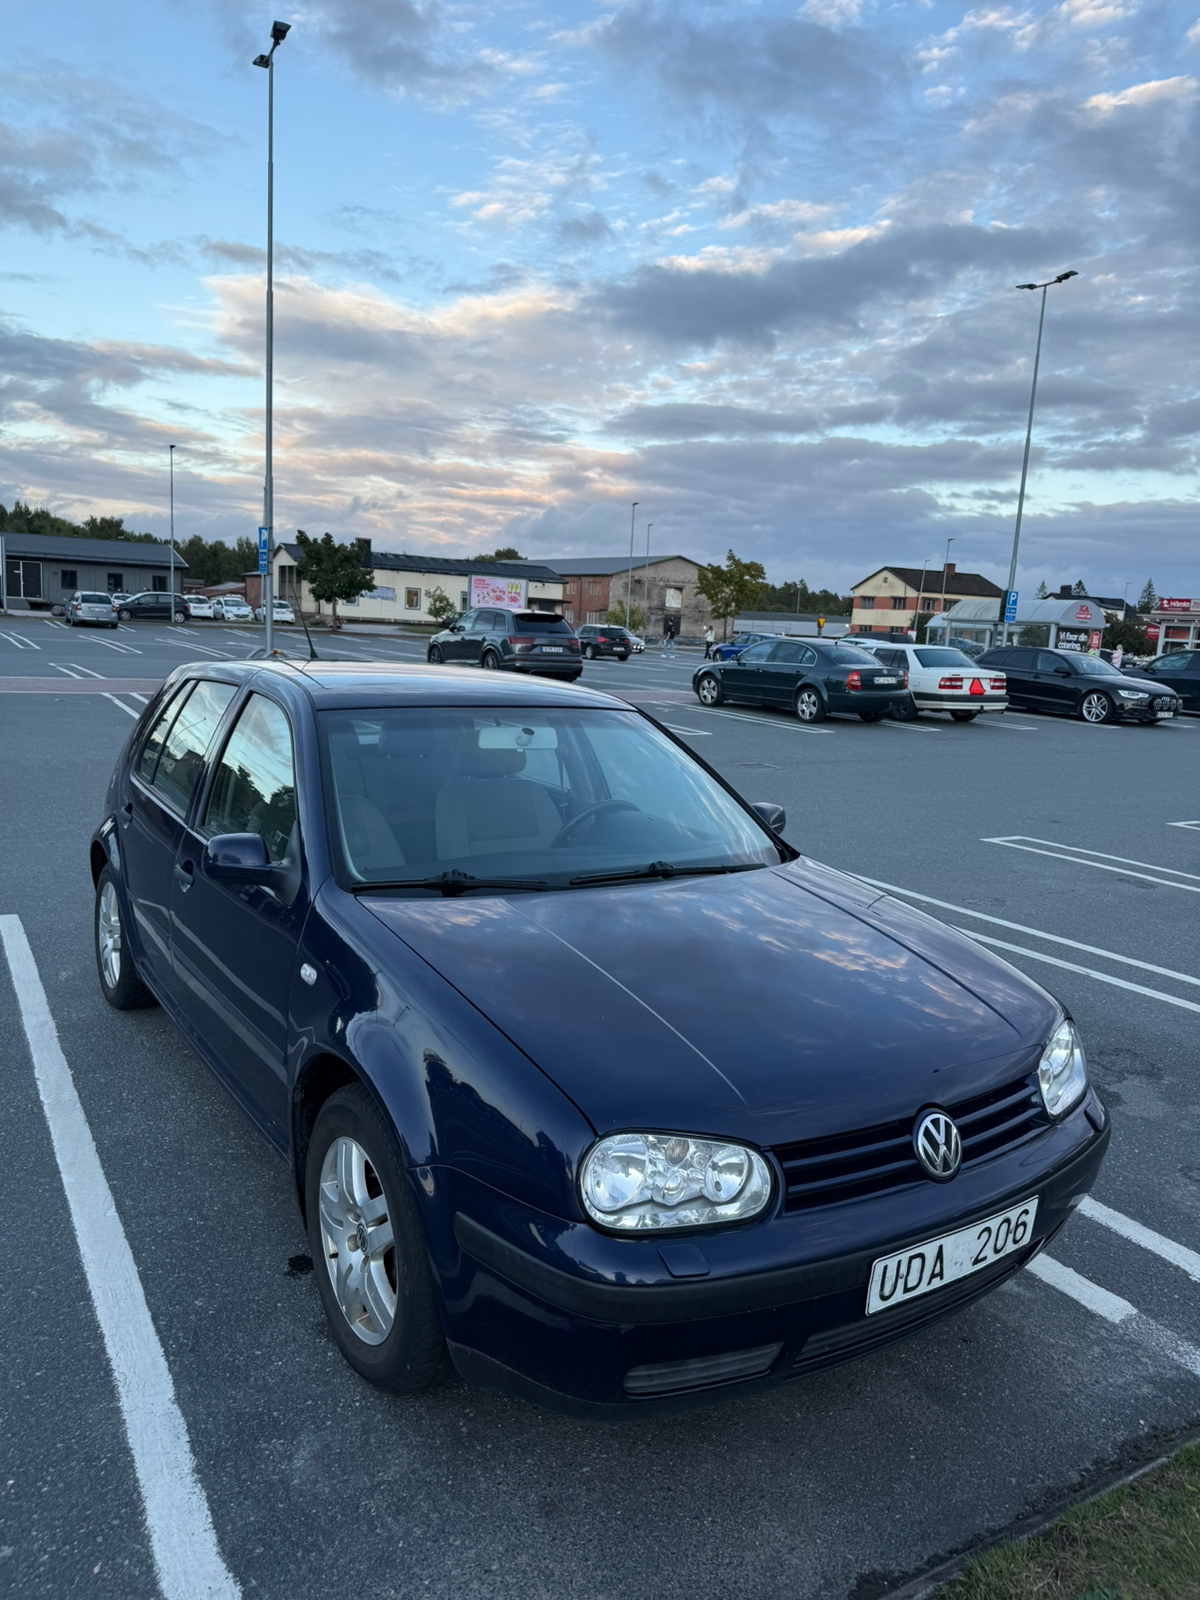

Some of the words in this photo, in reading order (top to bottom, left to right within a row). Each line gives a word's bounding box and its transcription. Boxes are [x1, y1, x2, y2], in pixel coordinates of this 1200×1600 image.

[1009, 592, 1017, 605] P
[1078, 604, 1089, 613] ICA
[1059, 632, 1066, 641] Vi
[1066, 631, 1079, 641] fixar
[1078, 633, 1088, 641] din
[878, 1243, 944, 1302] UDA
[971, 1208, 1030, 1267] 206
